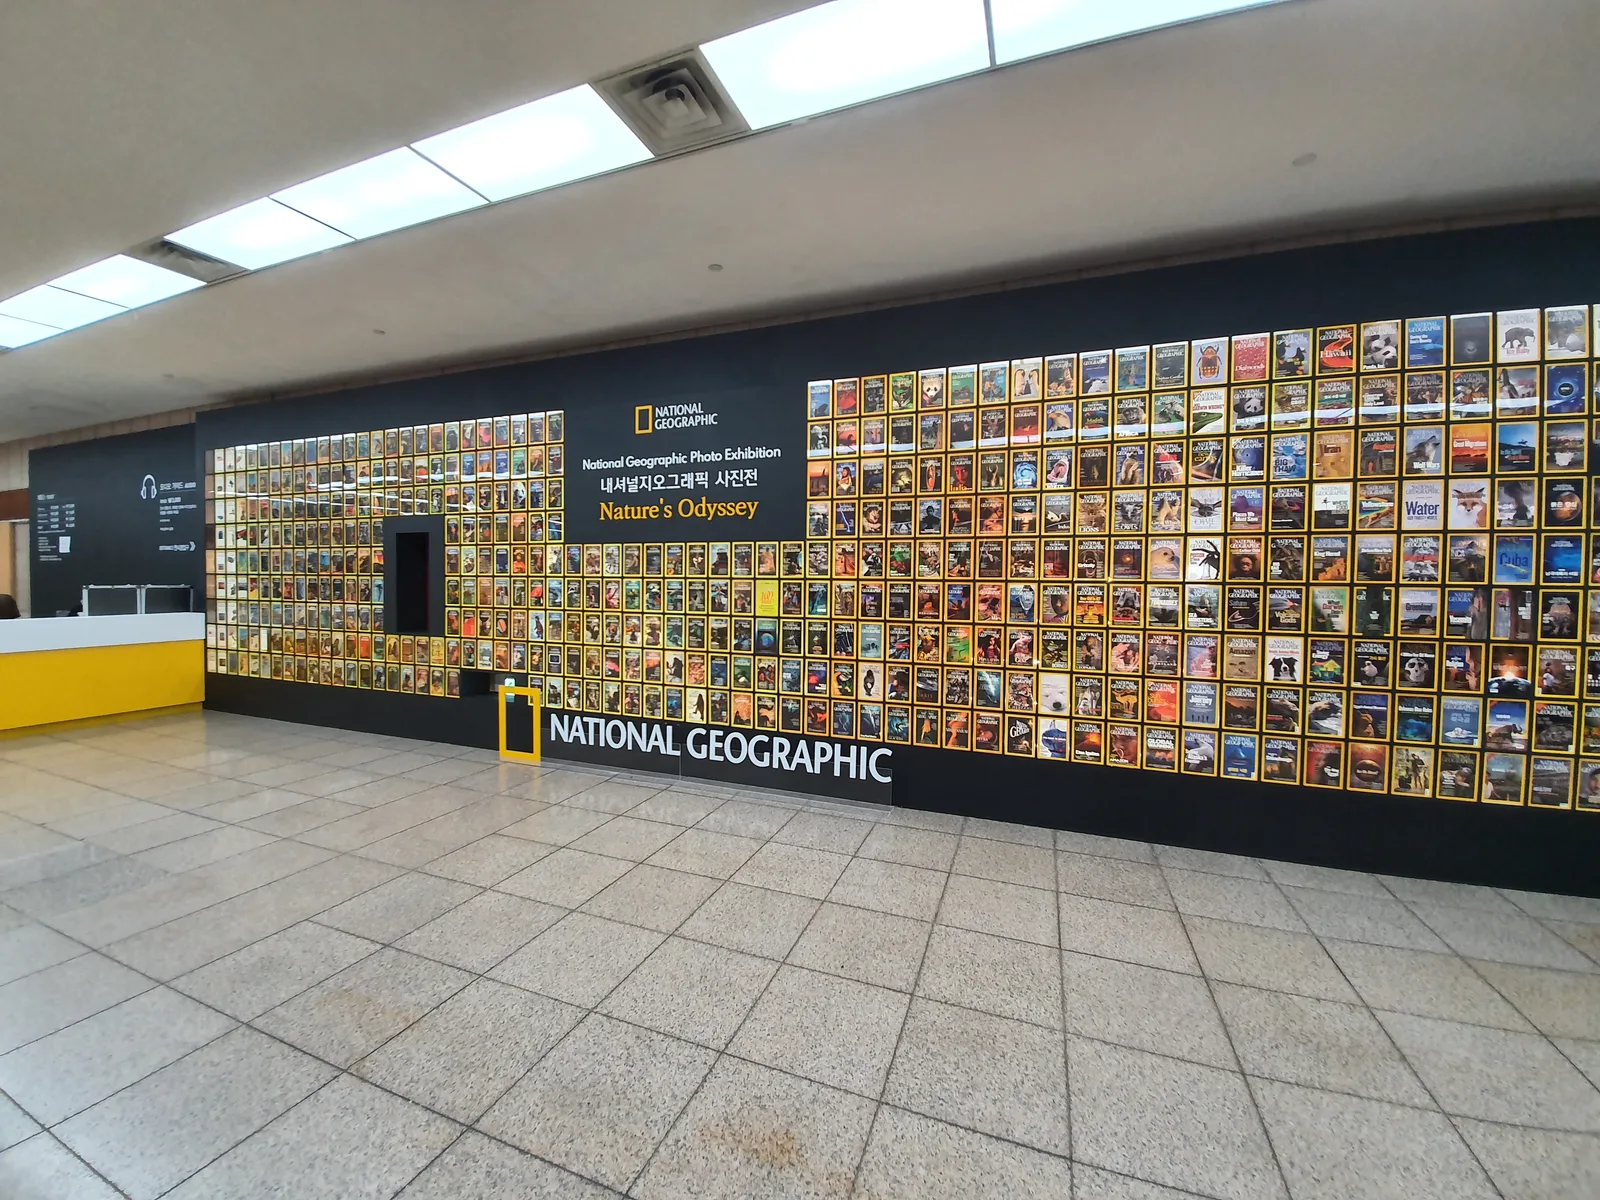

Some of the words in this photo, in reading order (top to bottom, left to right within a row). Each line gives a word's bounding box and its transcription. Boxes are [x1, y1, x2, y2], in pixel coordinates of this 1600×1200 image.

[1320, 350, 1351, 358] Hawaii
[655, 403, 703, 417] NATIONAL
[655, 413, 718, 430] GEOGRAPHIC
[583, 456, 624, 471] National
[625, 452, 687, 469] Geographic
[690, 450, 722, 462] Photo
[725, 446, 781, 460] Exhibition
[601, 471, 709, 493] 내셔널지오그래픽
[715, 468, 758, 488] 사진전
[599, 498, 672, 521] Nature's
[678, 497, 759, 520] Odyssey
[1405, 501, 1439, 515] Water
[1500, 553, 1528, 566] Cuba
[1228, 648, 1256, 656] Amazon
[550, 713, 681, 756] NATIONAL
[687, 727, 892, 783] GEOGRAPHIC
